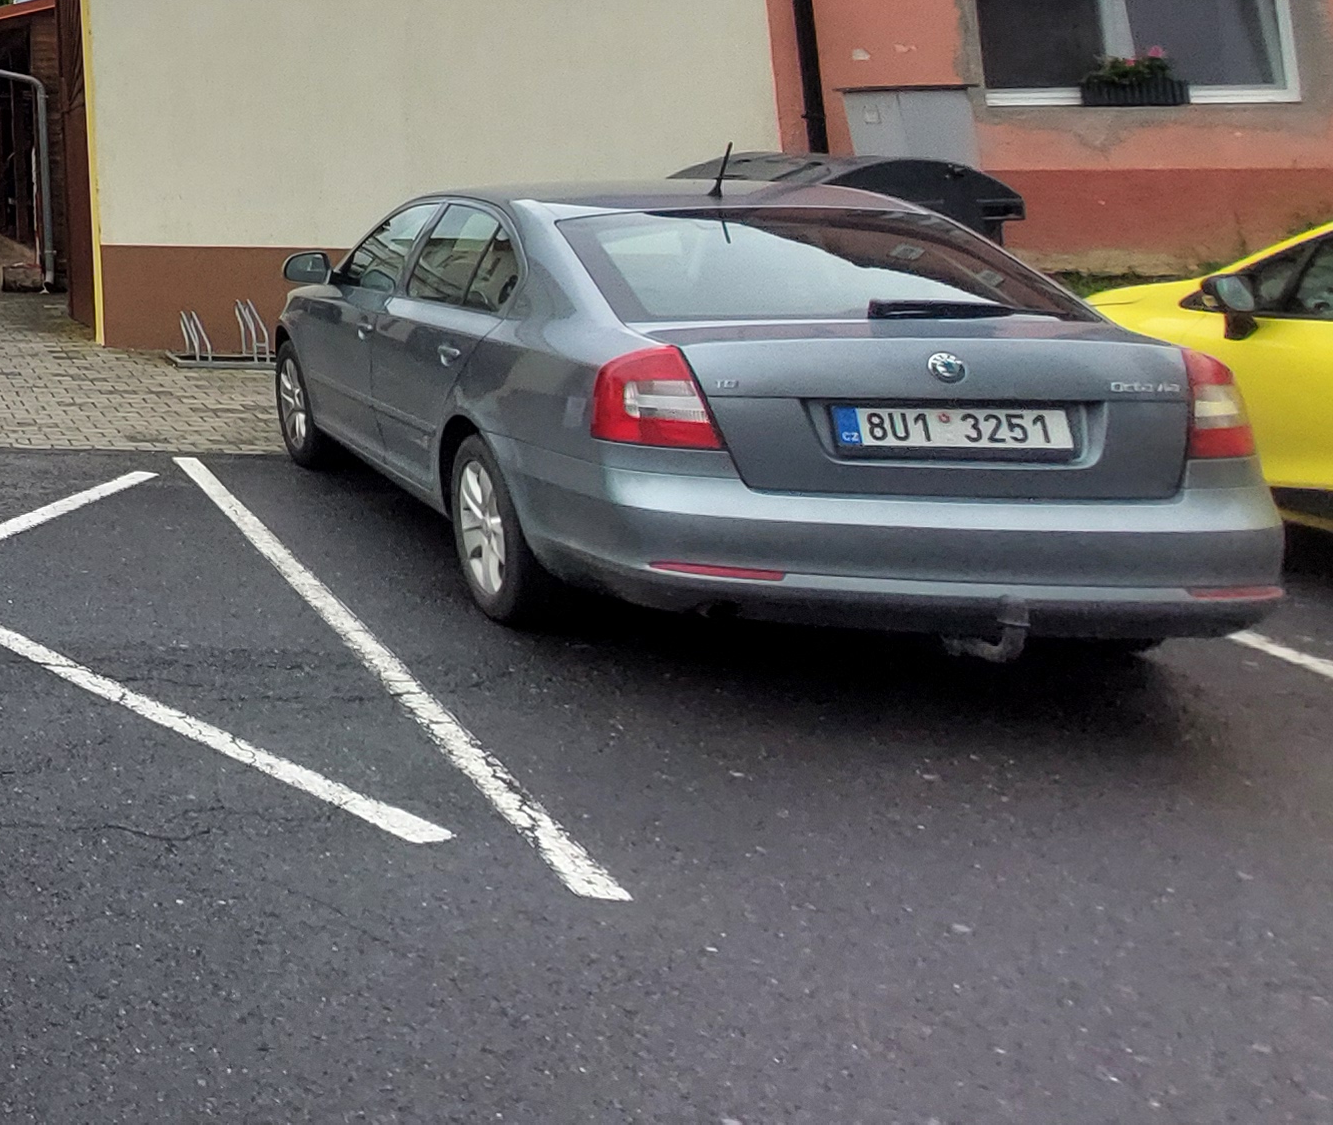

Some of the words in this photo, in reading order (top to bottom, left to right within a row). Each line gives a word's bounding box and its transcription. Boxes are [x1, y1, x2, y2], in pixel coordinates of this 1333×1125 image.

[842, 431, 860, 443] CZ
[867, 412, 933, 443] 8U1
[960, 412, 1052, 444] 3251
